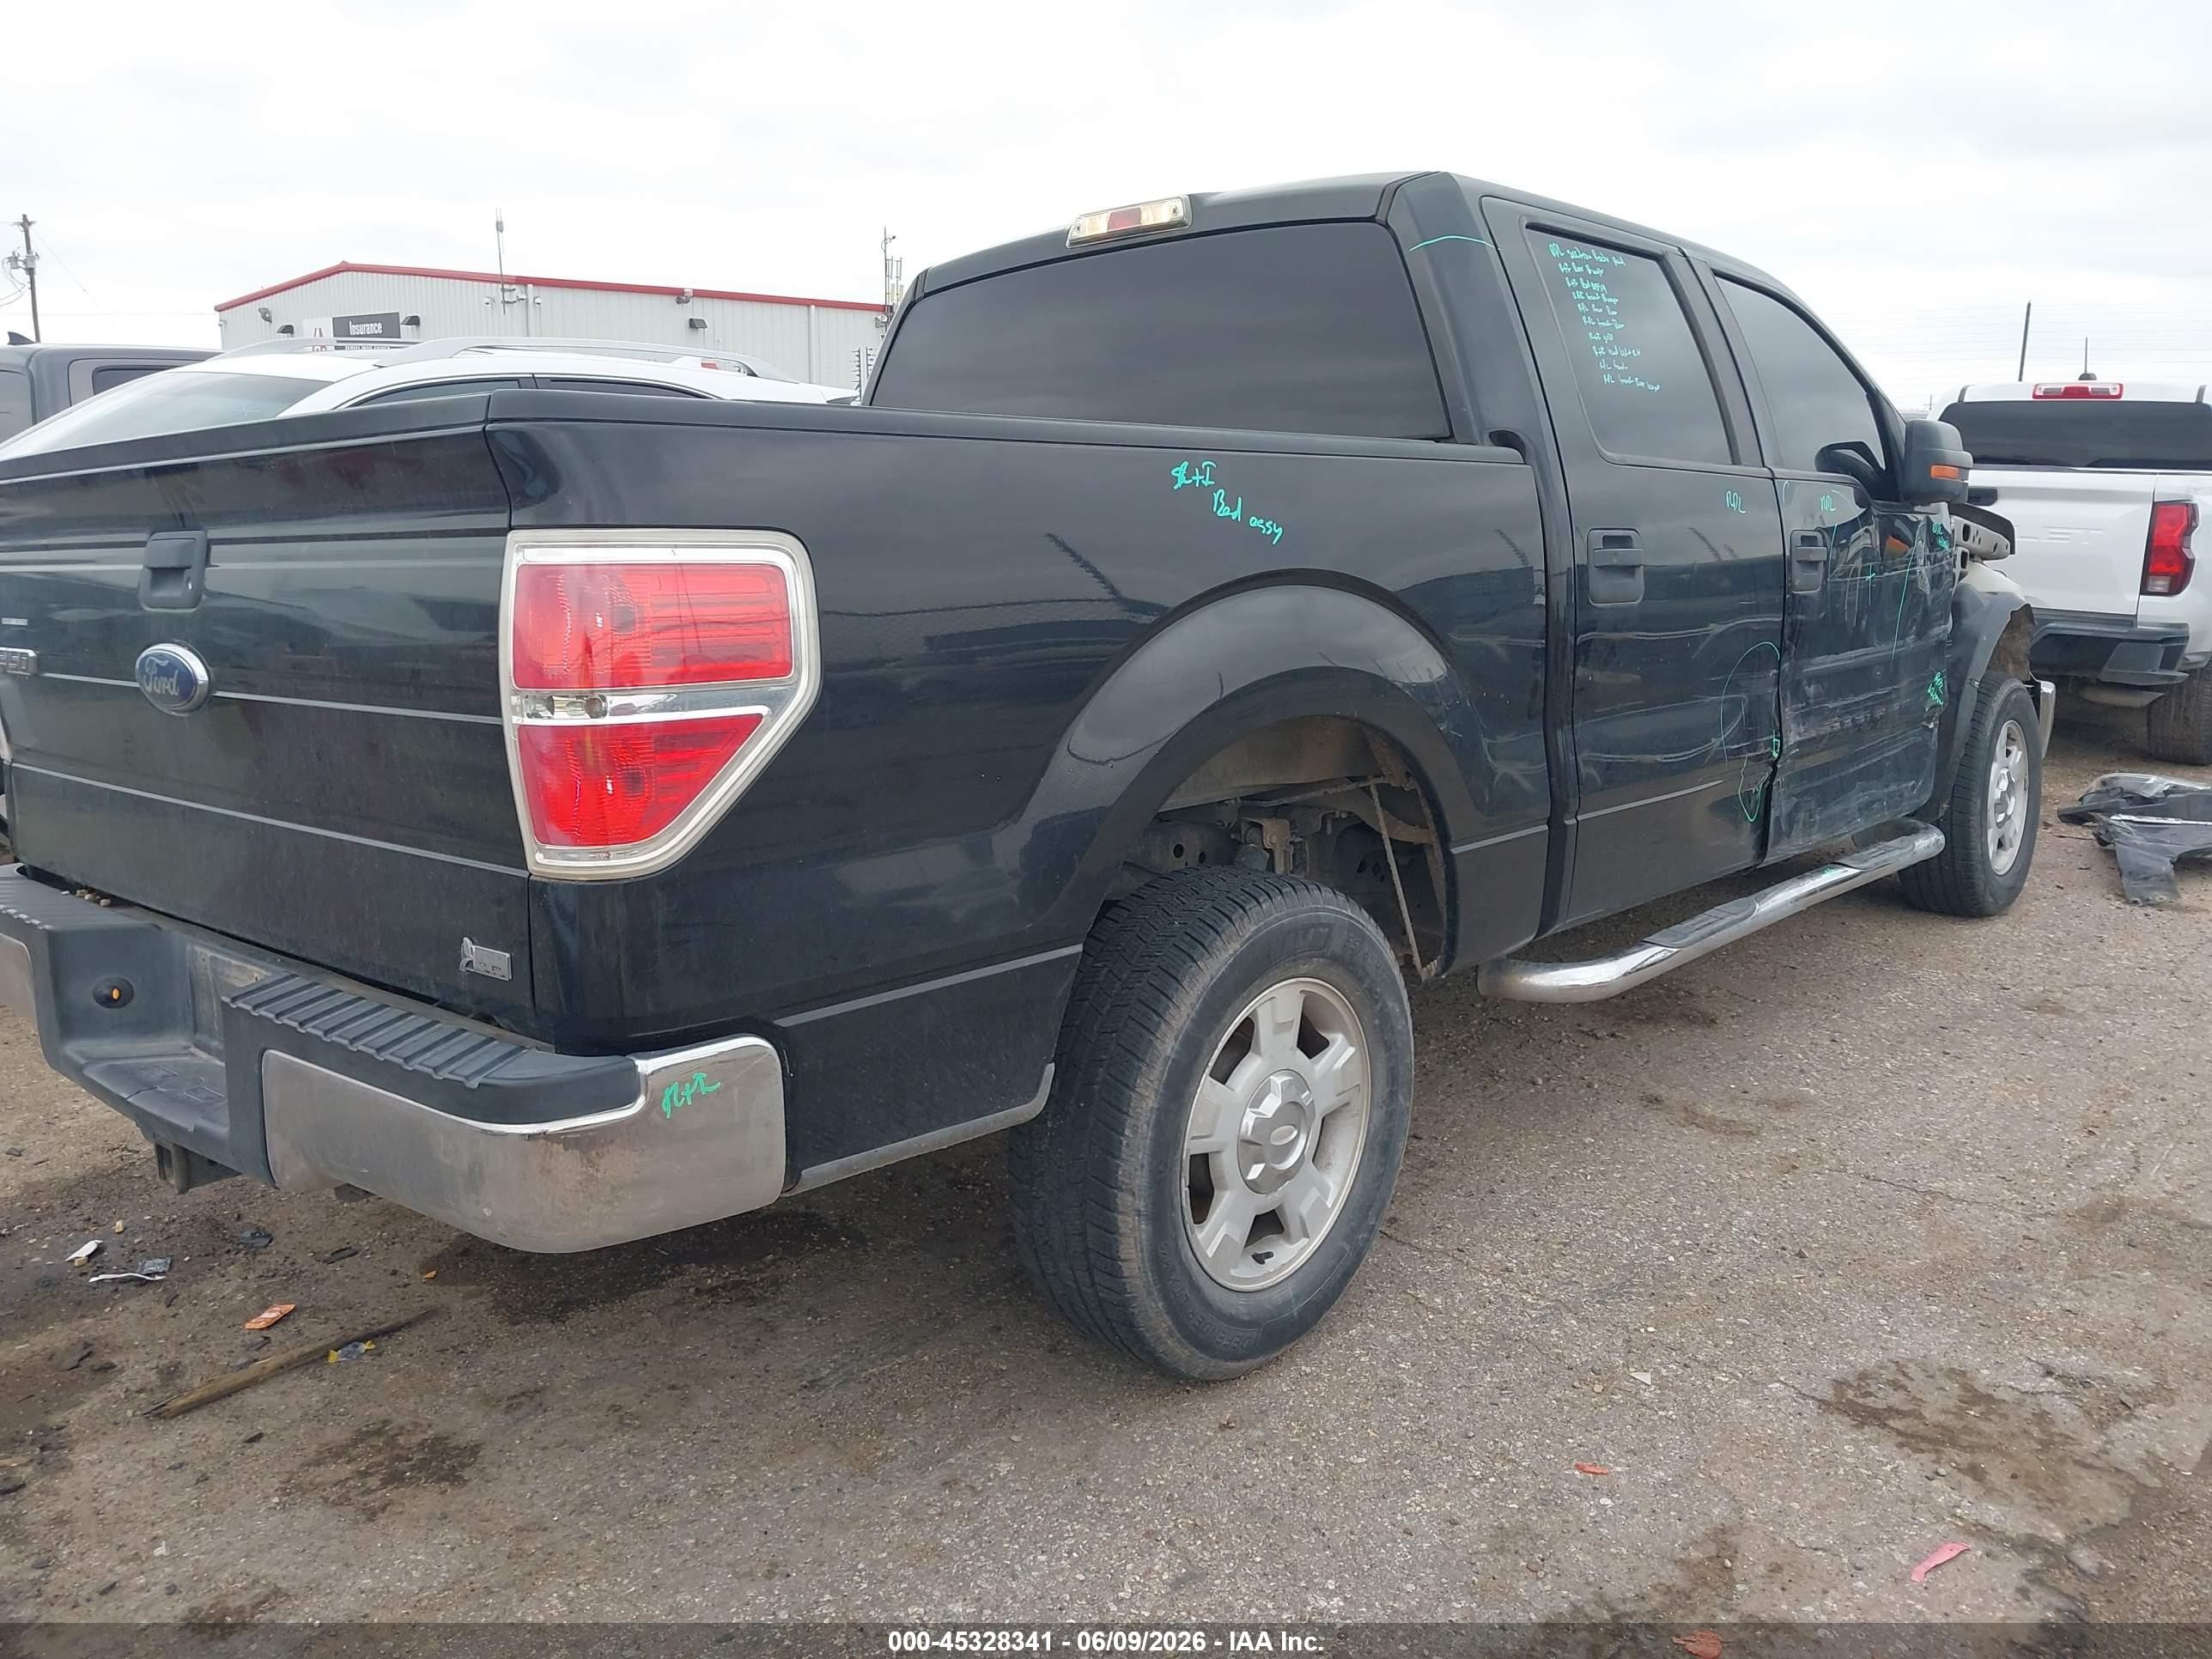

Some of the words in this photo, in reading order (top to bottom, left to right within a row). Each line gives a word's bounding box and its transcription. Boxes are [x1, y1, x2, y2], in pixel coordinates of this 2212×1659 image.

[349, 320, 383, 336] Insurance
[1212, 489, 1243, 521] Bed
[143, 656, 180, 696] Ford
[1188, 1309, 1255, 1350] DEFENDER
